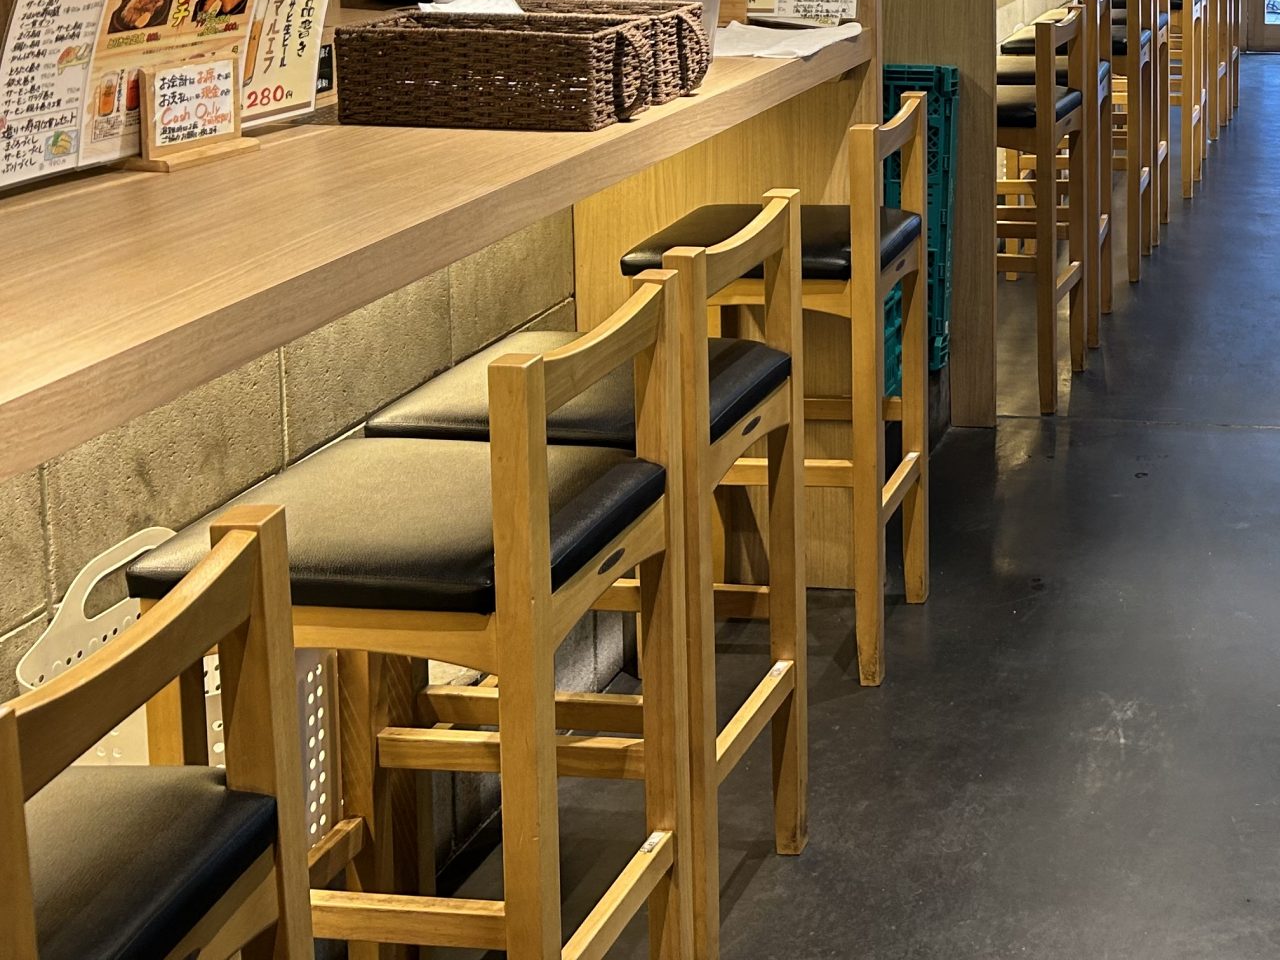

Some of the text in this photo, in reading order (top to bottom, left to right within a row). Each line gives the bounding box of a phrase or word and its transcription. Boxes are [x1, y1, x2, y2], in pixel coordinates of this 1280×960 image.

[246, 84, 294, 110] 280円
[161, 102, 221, 126] Cash Only
